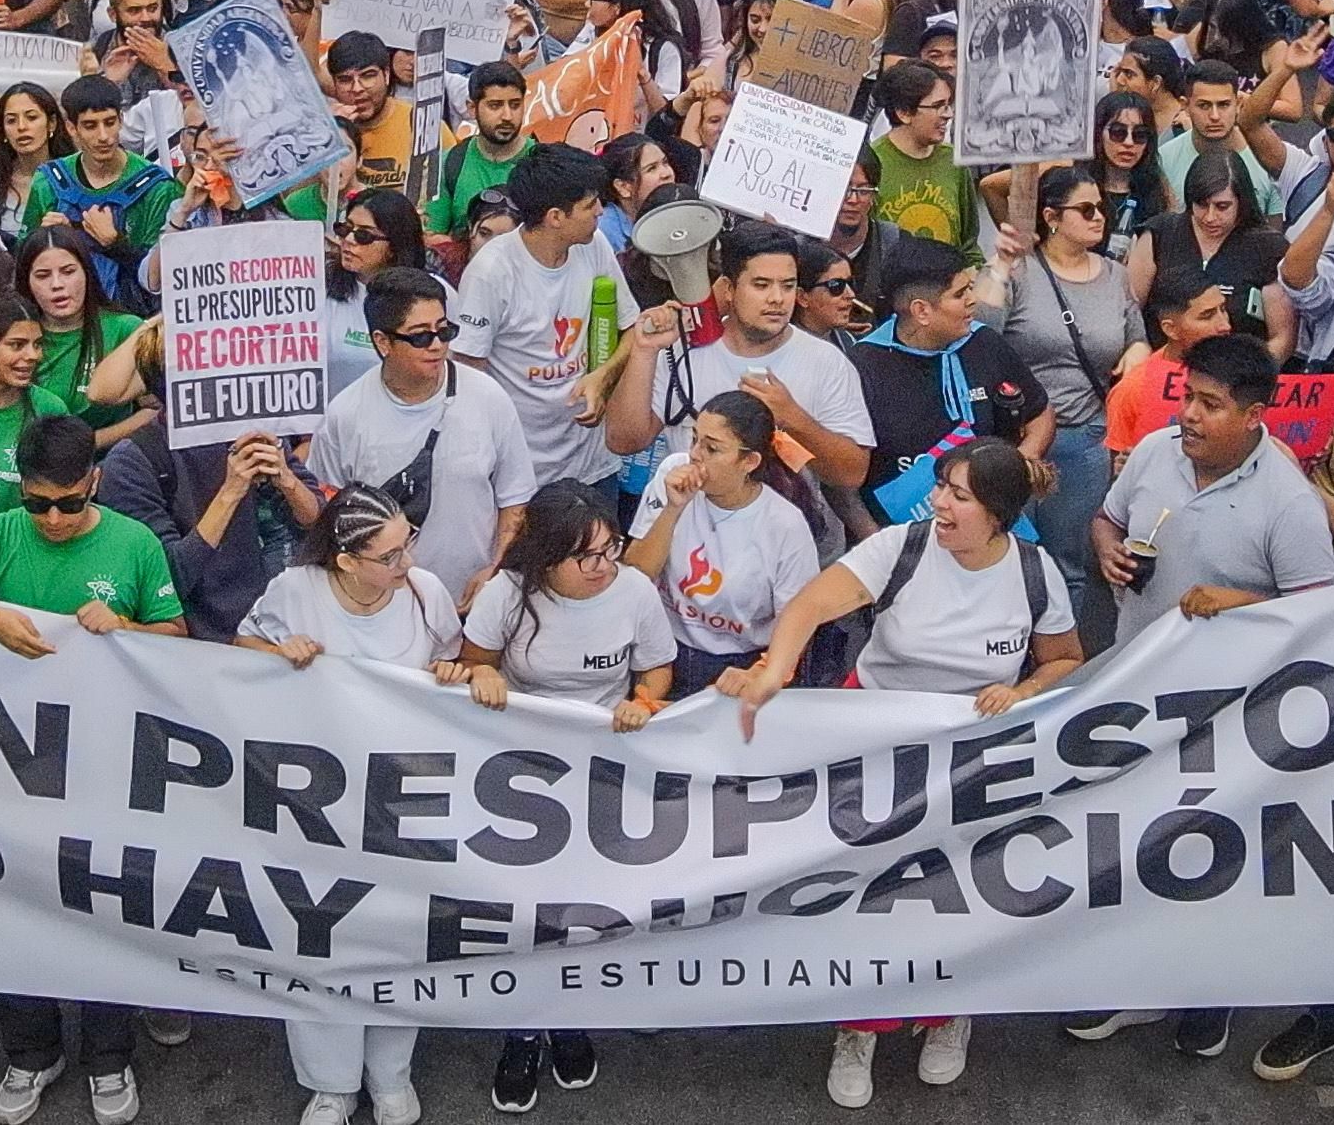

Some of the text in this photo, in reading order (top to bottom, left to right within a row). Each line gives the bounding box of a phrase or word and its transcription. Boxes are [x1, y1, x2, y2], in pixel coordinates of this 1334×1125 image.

[397, 11, 423, 34] NO
[741, 85, 814, 116] UNIVERSIDAD
[736, 172, 813, 212] AJUSTE!
[782, 159, 812, 190] AL
[172, 255, 316, 291] SI NOS RECORTAN
[175, 286, 316, 324] EL PRESUPUESTO
[175, 321, 318, 372] RECORTAN
[178, 371, 317, 423] EL FUTURO
[58, 836, 377, 960] HAY
[177, 956, 954, 1006] ESTAMENTO ESTUDIANTIL
